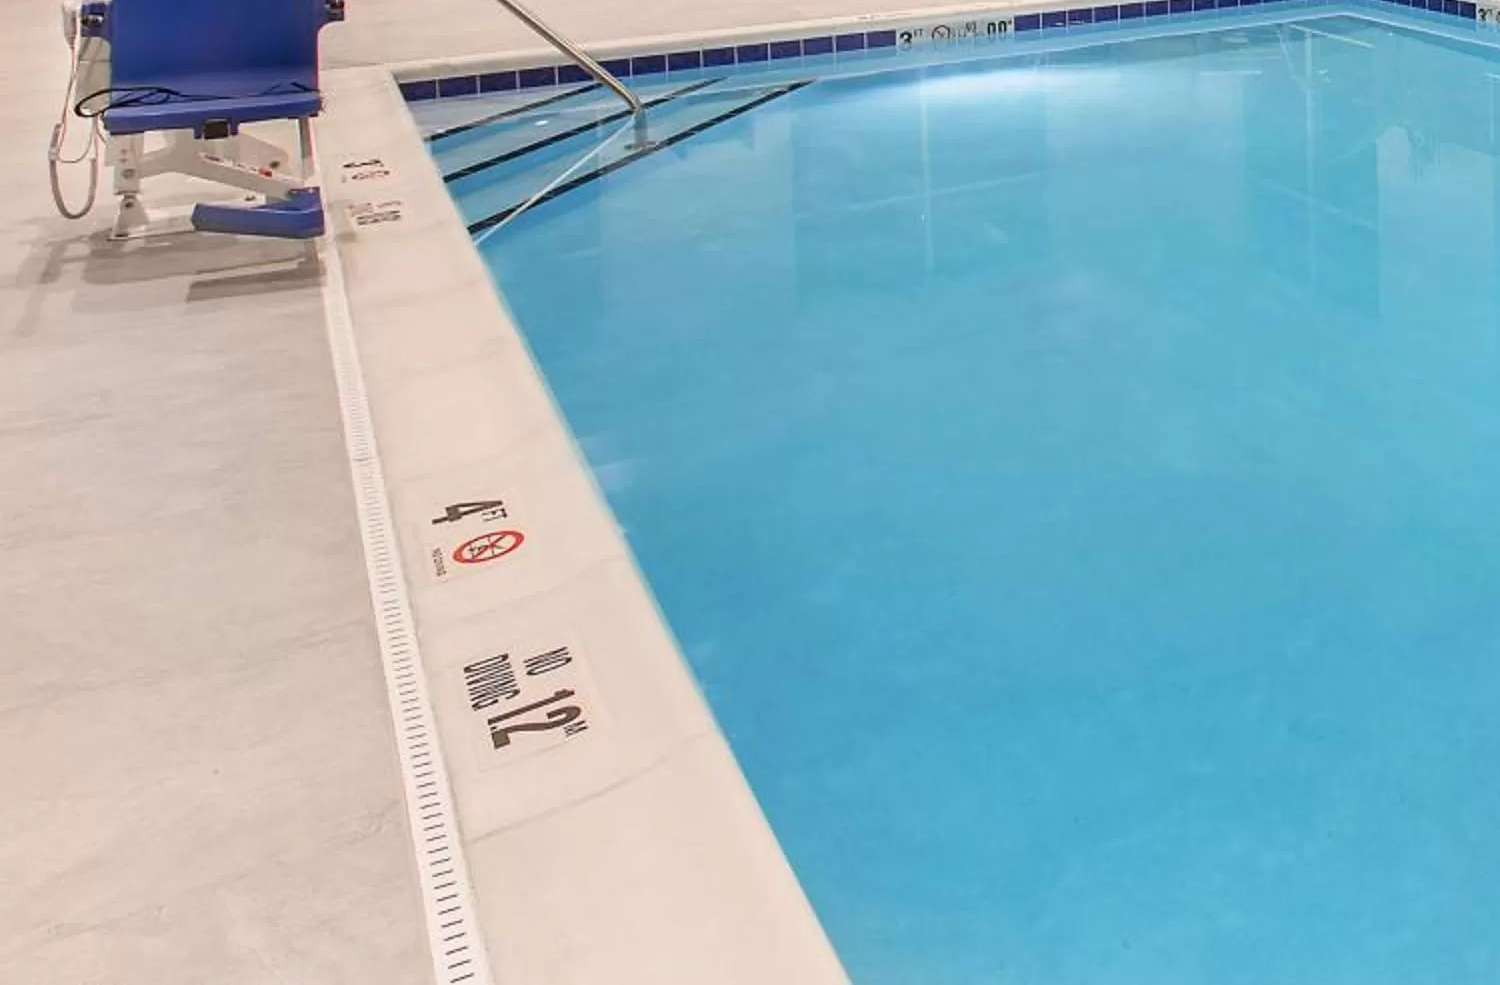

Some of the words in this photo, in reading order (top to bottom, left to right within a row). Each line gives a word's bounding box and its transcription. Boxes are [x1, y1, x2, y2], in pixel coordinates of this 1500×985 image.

[432, 500, 503, 524] 4
[523, 646, 572, 676] NO
[463, 653, 520, 711] DIVING
